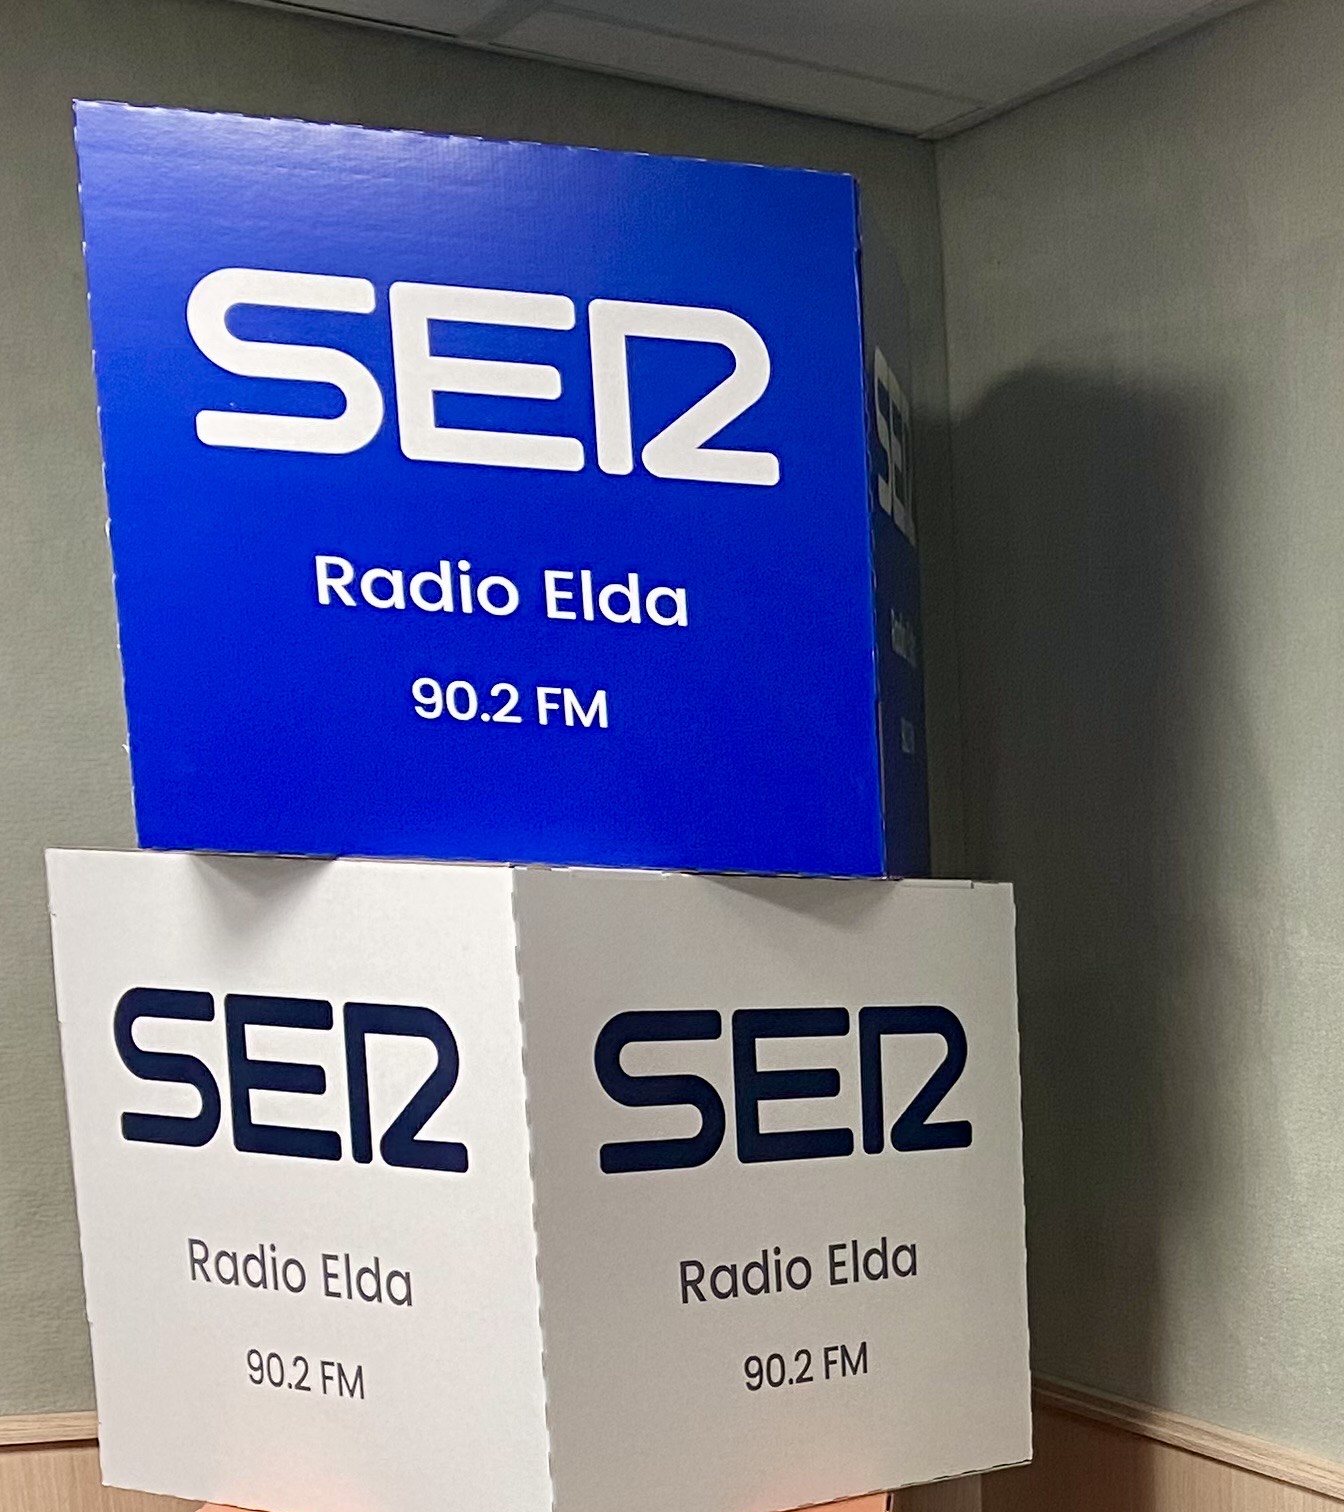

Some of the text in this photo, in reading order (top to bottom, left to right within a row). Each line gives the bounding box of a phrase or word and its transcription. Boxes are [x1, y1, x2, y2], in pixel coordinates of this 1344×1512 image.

[187, 268, 779, 485] SER
[316, 556, 687, 626] Radio Elda
[412, 678, 608, 728] 90.2 FM
[114, 987, 468, 1173] SER
[594, 1006, 972, 1174] SER
[189, 1239, 412, 1306] Radio Elda
[680, 1237, 916, 1303] Radio Elda
[248, 1349, 364, 1399] 90.2 FM
[745, 1342, 867, 1391] 90.2 FM
